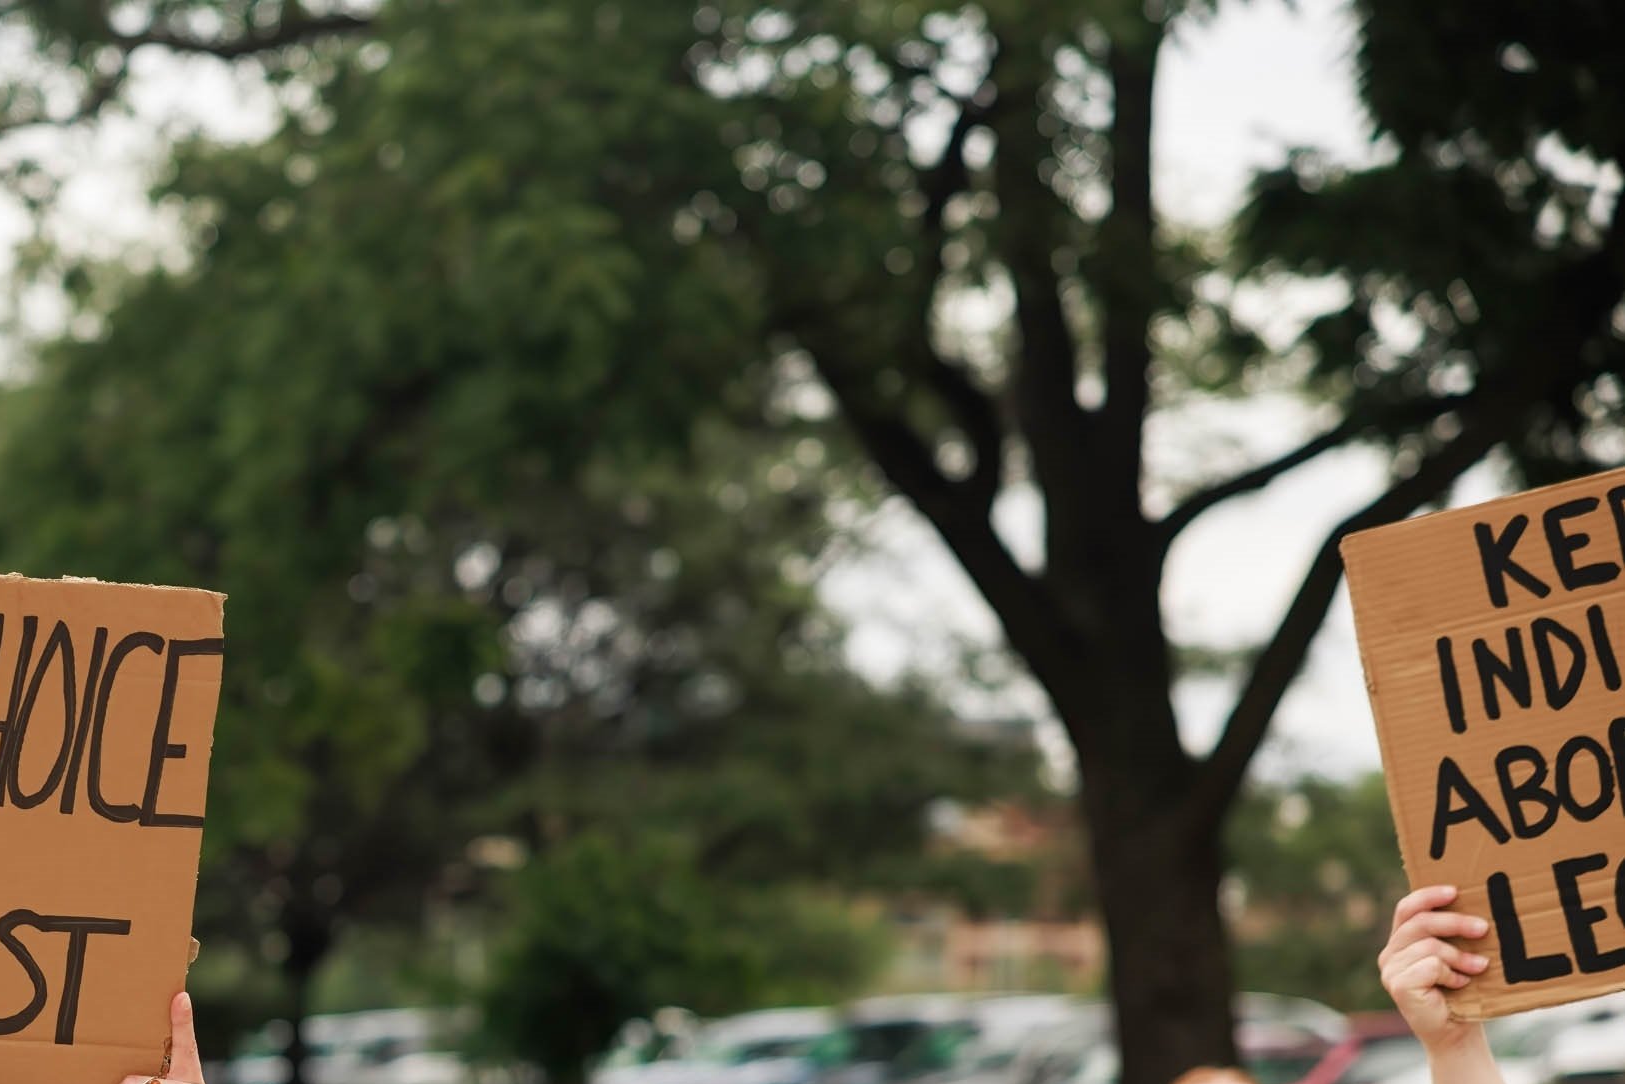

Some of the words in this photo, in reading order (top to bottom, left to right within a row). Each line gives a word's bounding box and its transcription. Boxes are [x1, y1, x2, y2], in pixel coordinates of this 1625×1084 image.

[1474, 485, 1625, 607] KE
[1437, 604, 1621, 734] INDI
[1430, 717, 1625, 859] ABO
[1487, 853, 1625, 984] LE
